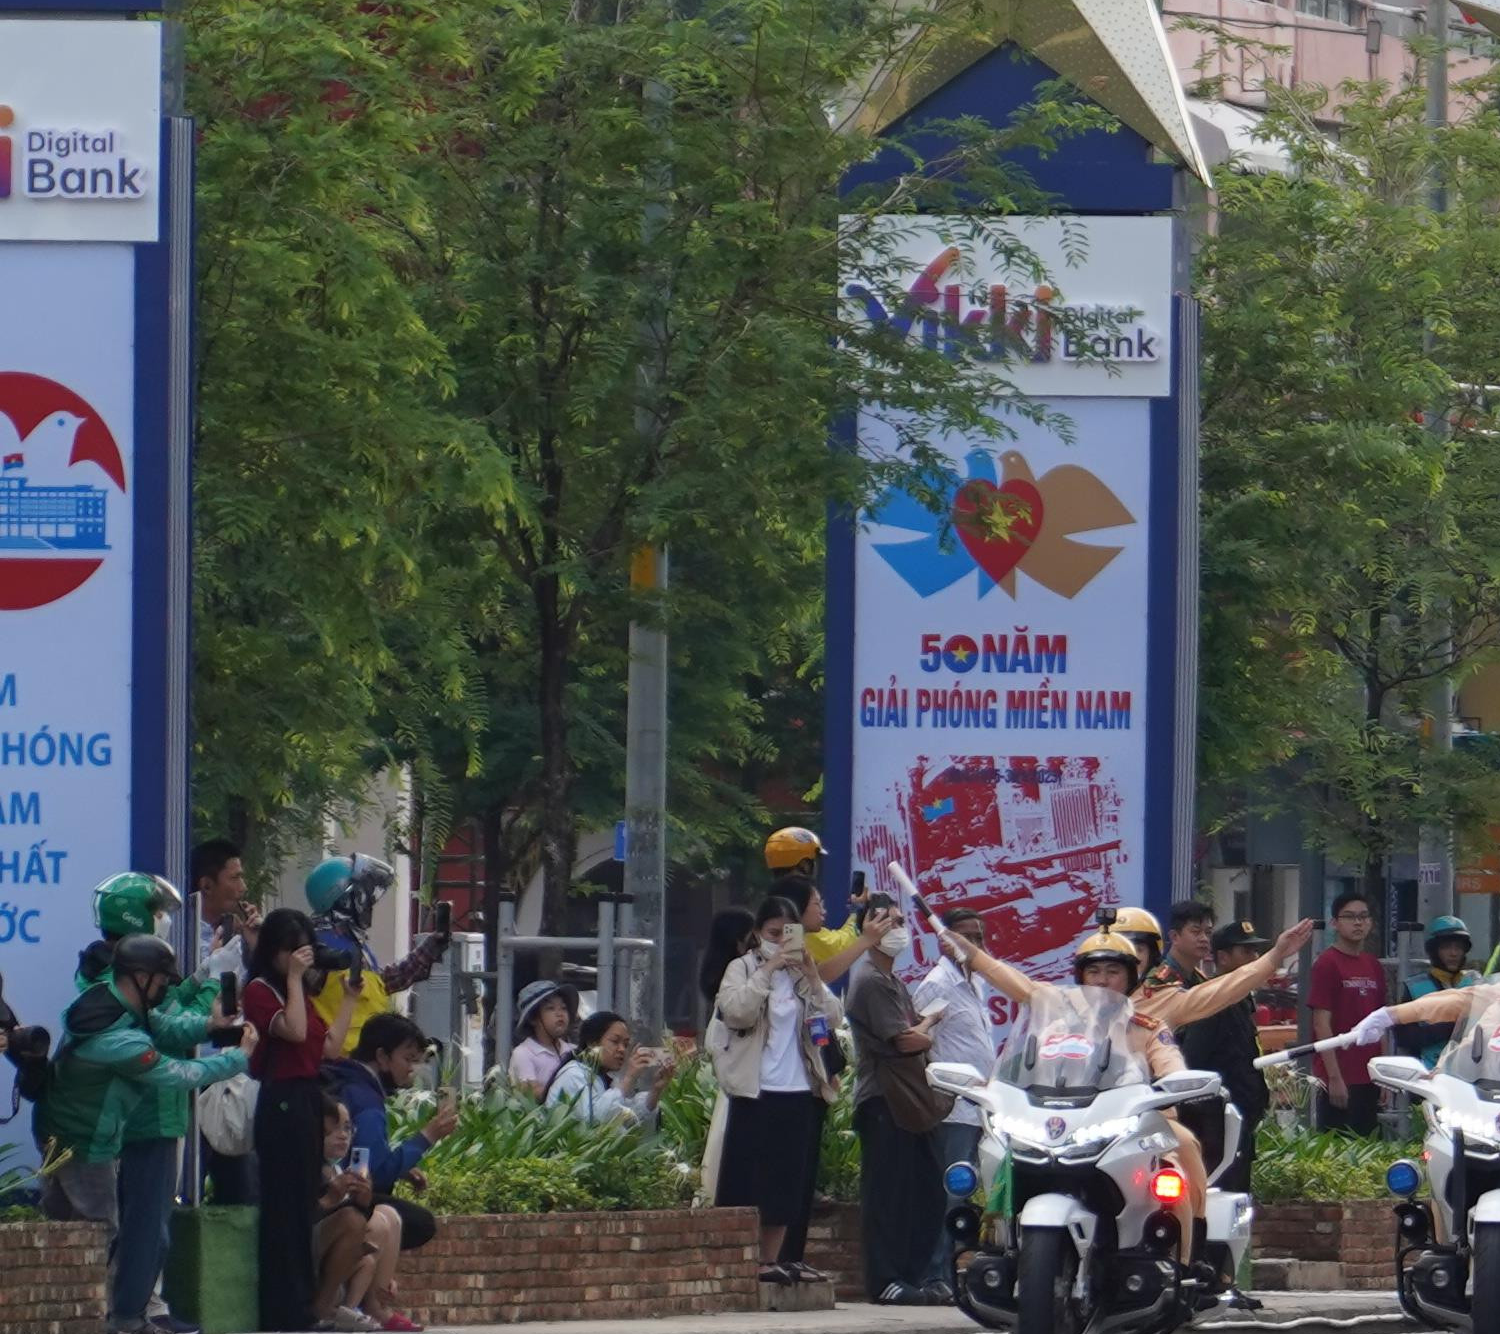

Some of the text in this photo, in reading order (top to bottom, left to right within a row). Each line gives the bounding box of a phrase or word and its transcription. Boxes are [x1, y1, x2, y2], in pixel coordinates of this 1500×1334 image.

[27, 131, 114, 158] Digital
[27, 158, 141, 195] Bank
[981, 625, 1067, 674] NĂM
[860, 675, 1131, 729] GIẢI PHÓNG MIỀN NAM
